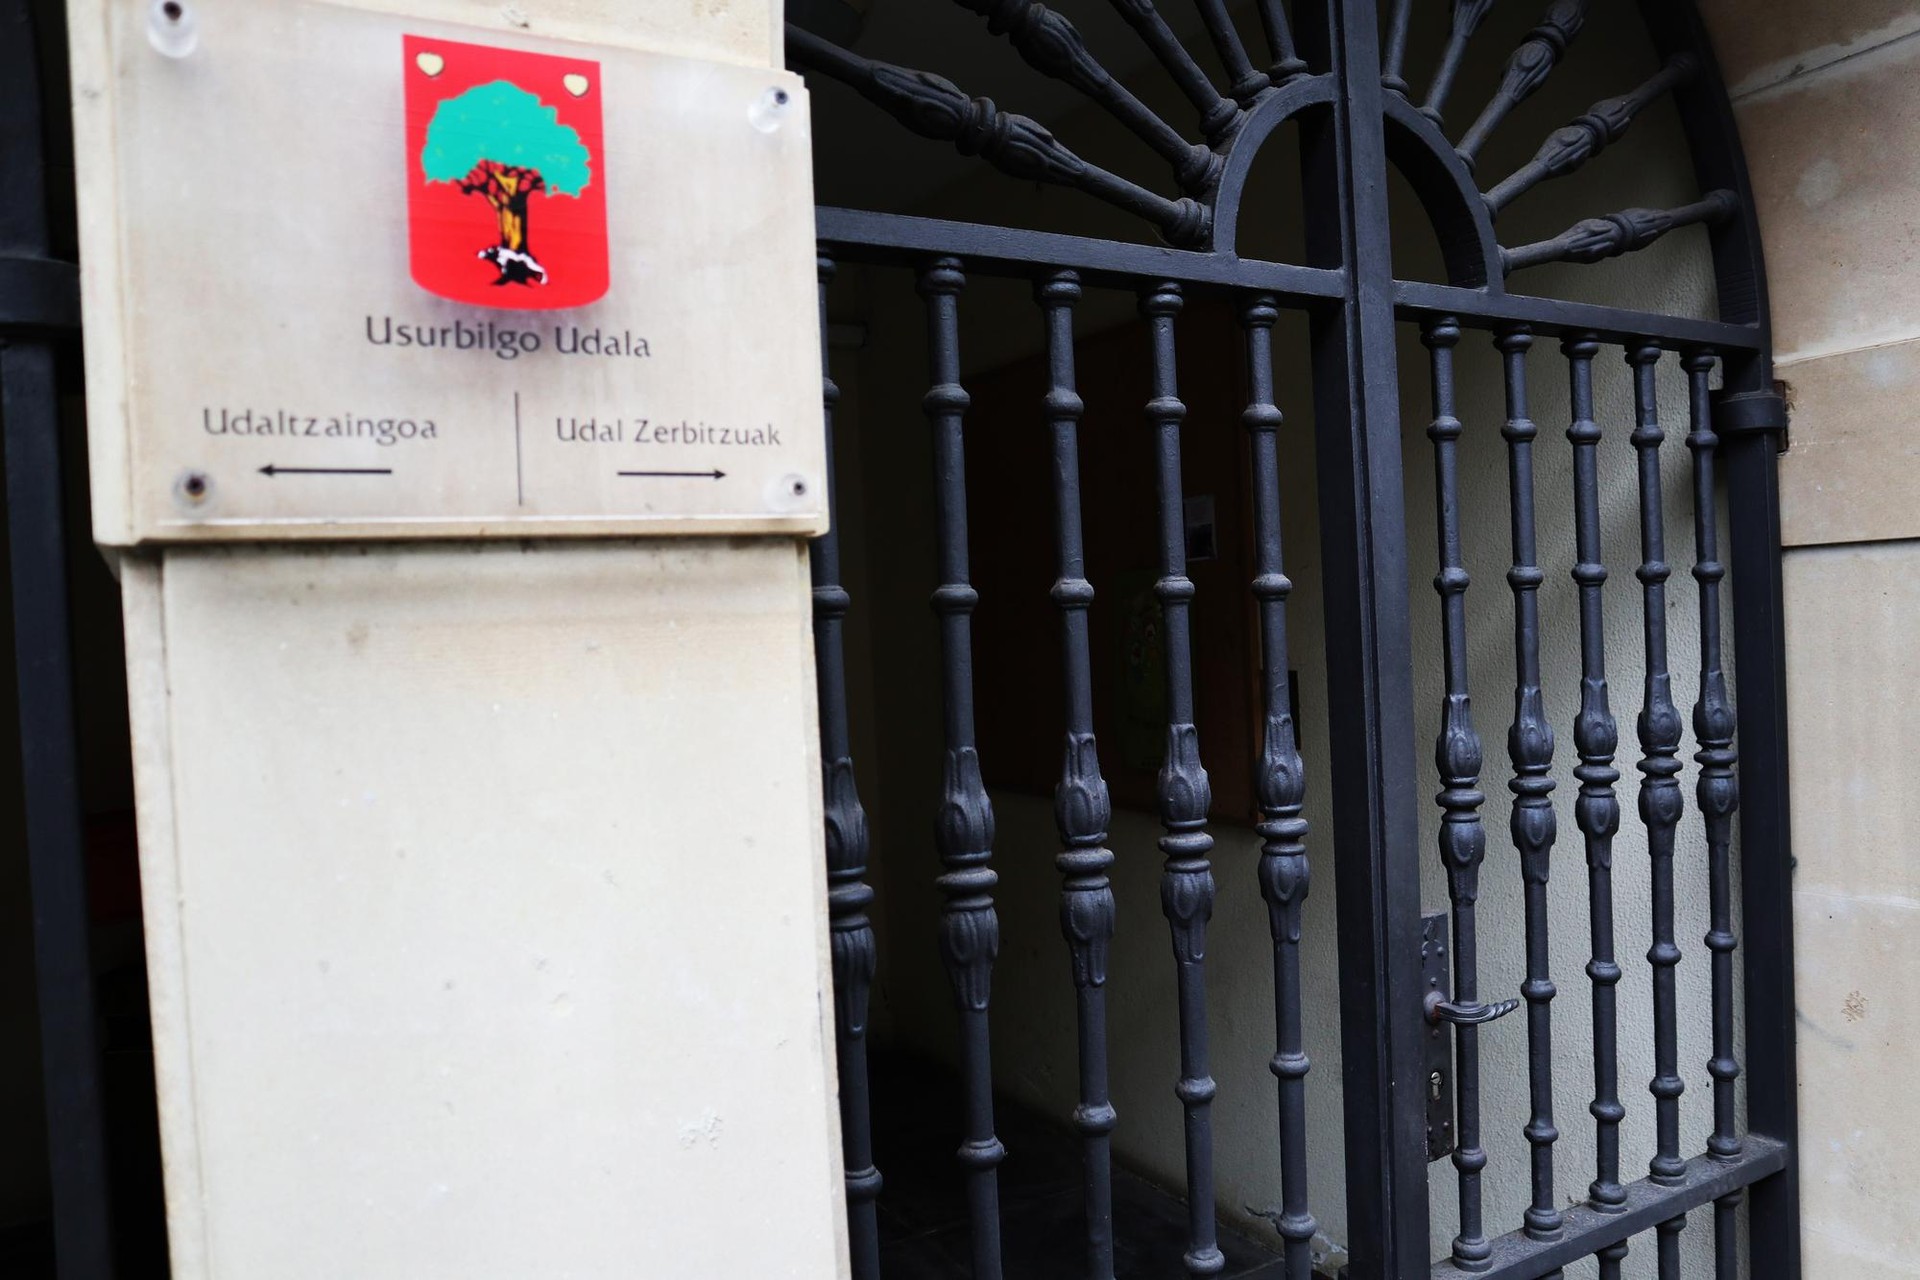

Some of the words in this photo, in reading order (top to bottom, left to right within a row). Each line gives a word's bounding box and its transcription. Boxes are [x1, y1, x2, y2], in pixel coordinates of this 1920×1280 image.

[366, 316, 541, 359] Usurbilgo
[555, 326, 652, 358] Udala
[203, 409, 438, 445] Udaltzaingoa
[556, 418, 622, 443] Udal
[633, 420, 781, 446] Zerbitzuak
